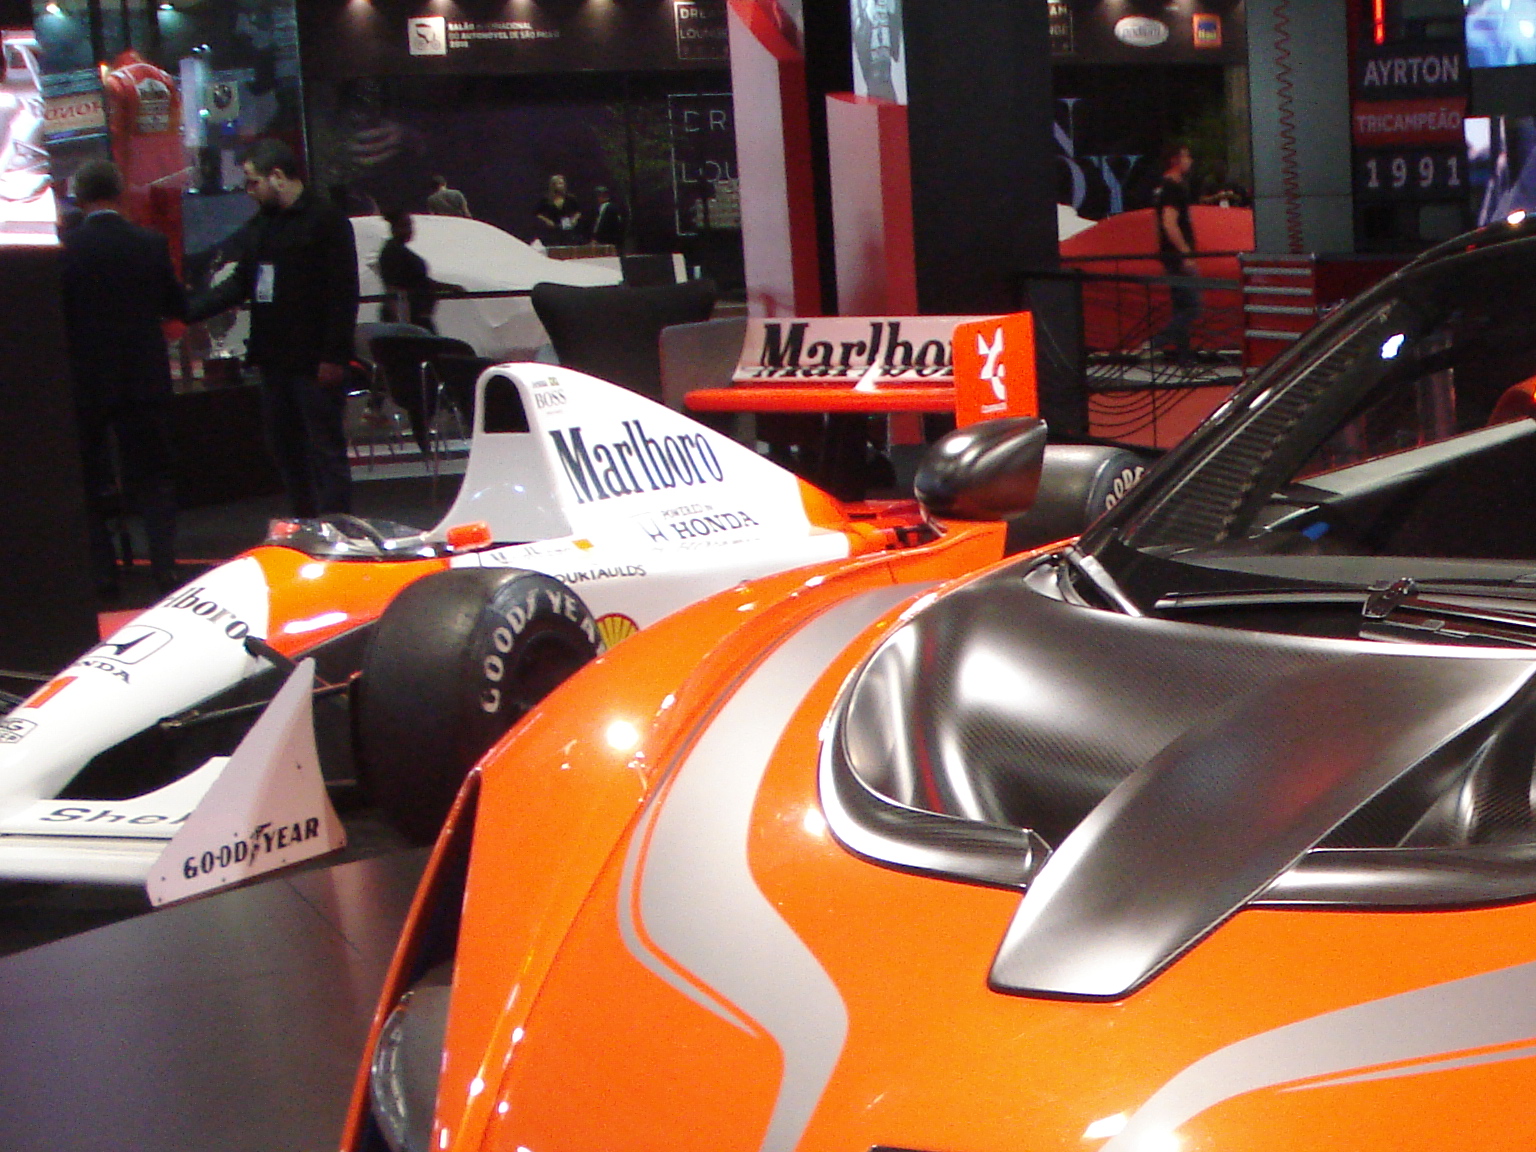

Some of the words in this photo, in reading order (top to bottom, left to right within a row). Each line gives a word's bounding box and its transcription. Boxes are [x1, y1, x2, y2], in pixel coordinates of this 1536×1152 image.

[1363, 55, 1459, 87] AYRTON
[1357, 107, 1460, 133] TRICAMPEÃO
[1366, 156, 1459, 188] 1991
[754, 321, 953, 378] Marlbo
[535, 388, 567, 410] BOSS
[548, 419, 724, 505] Marlboro
[669, 511, 760, 540] HONDA
